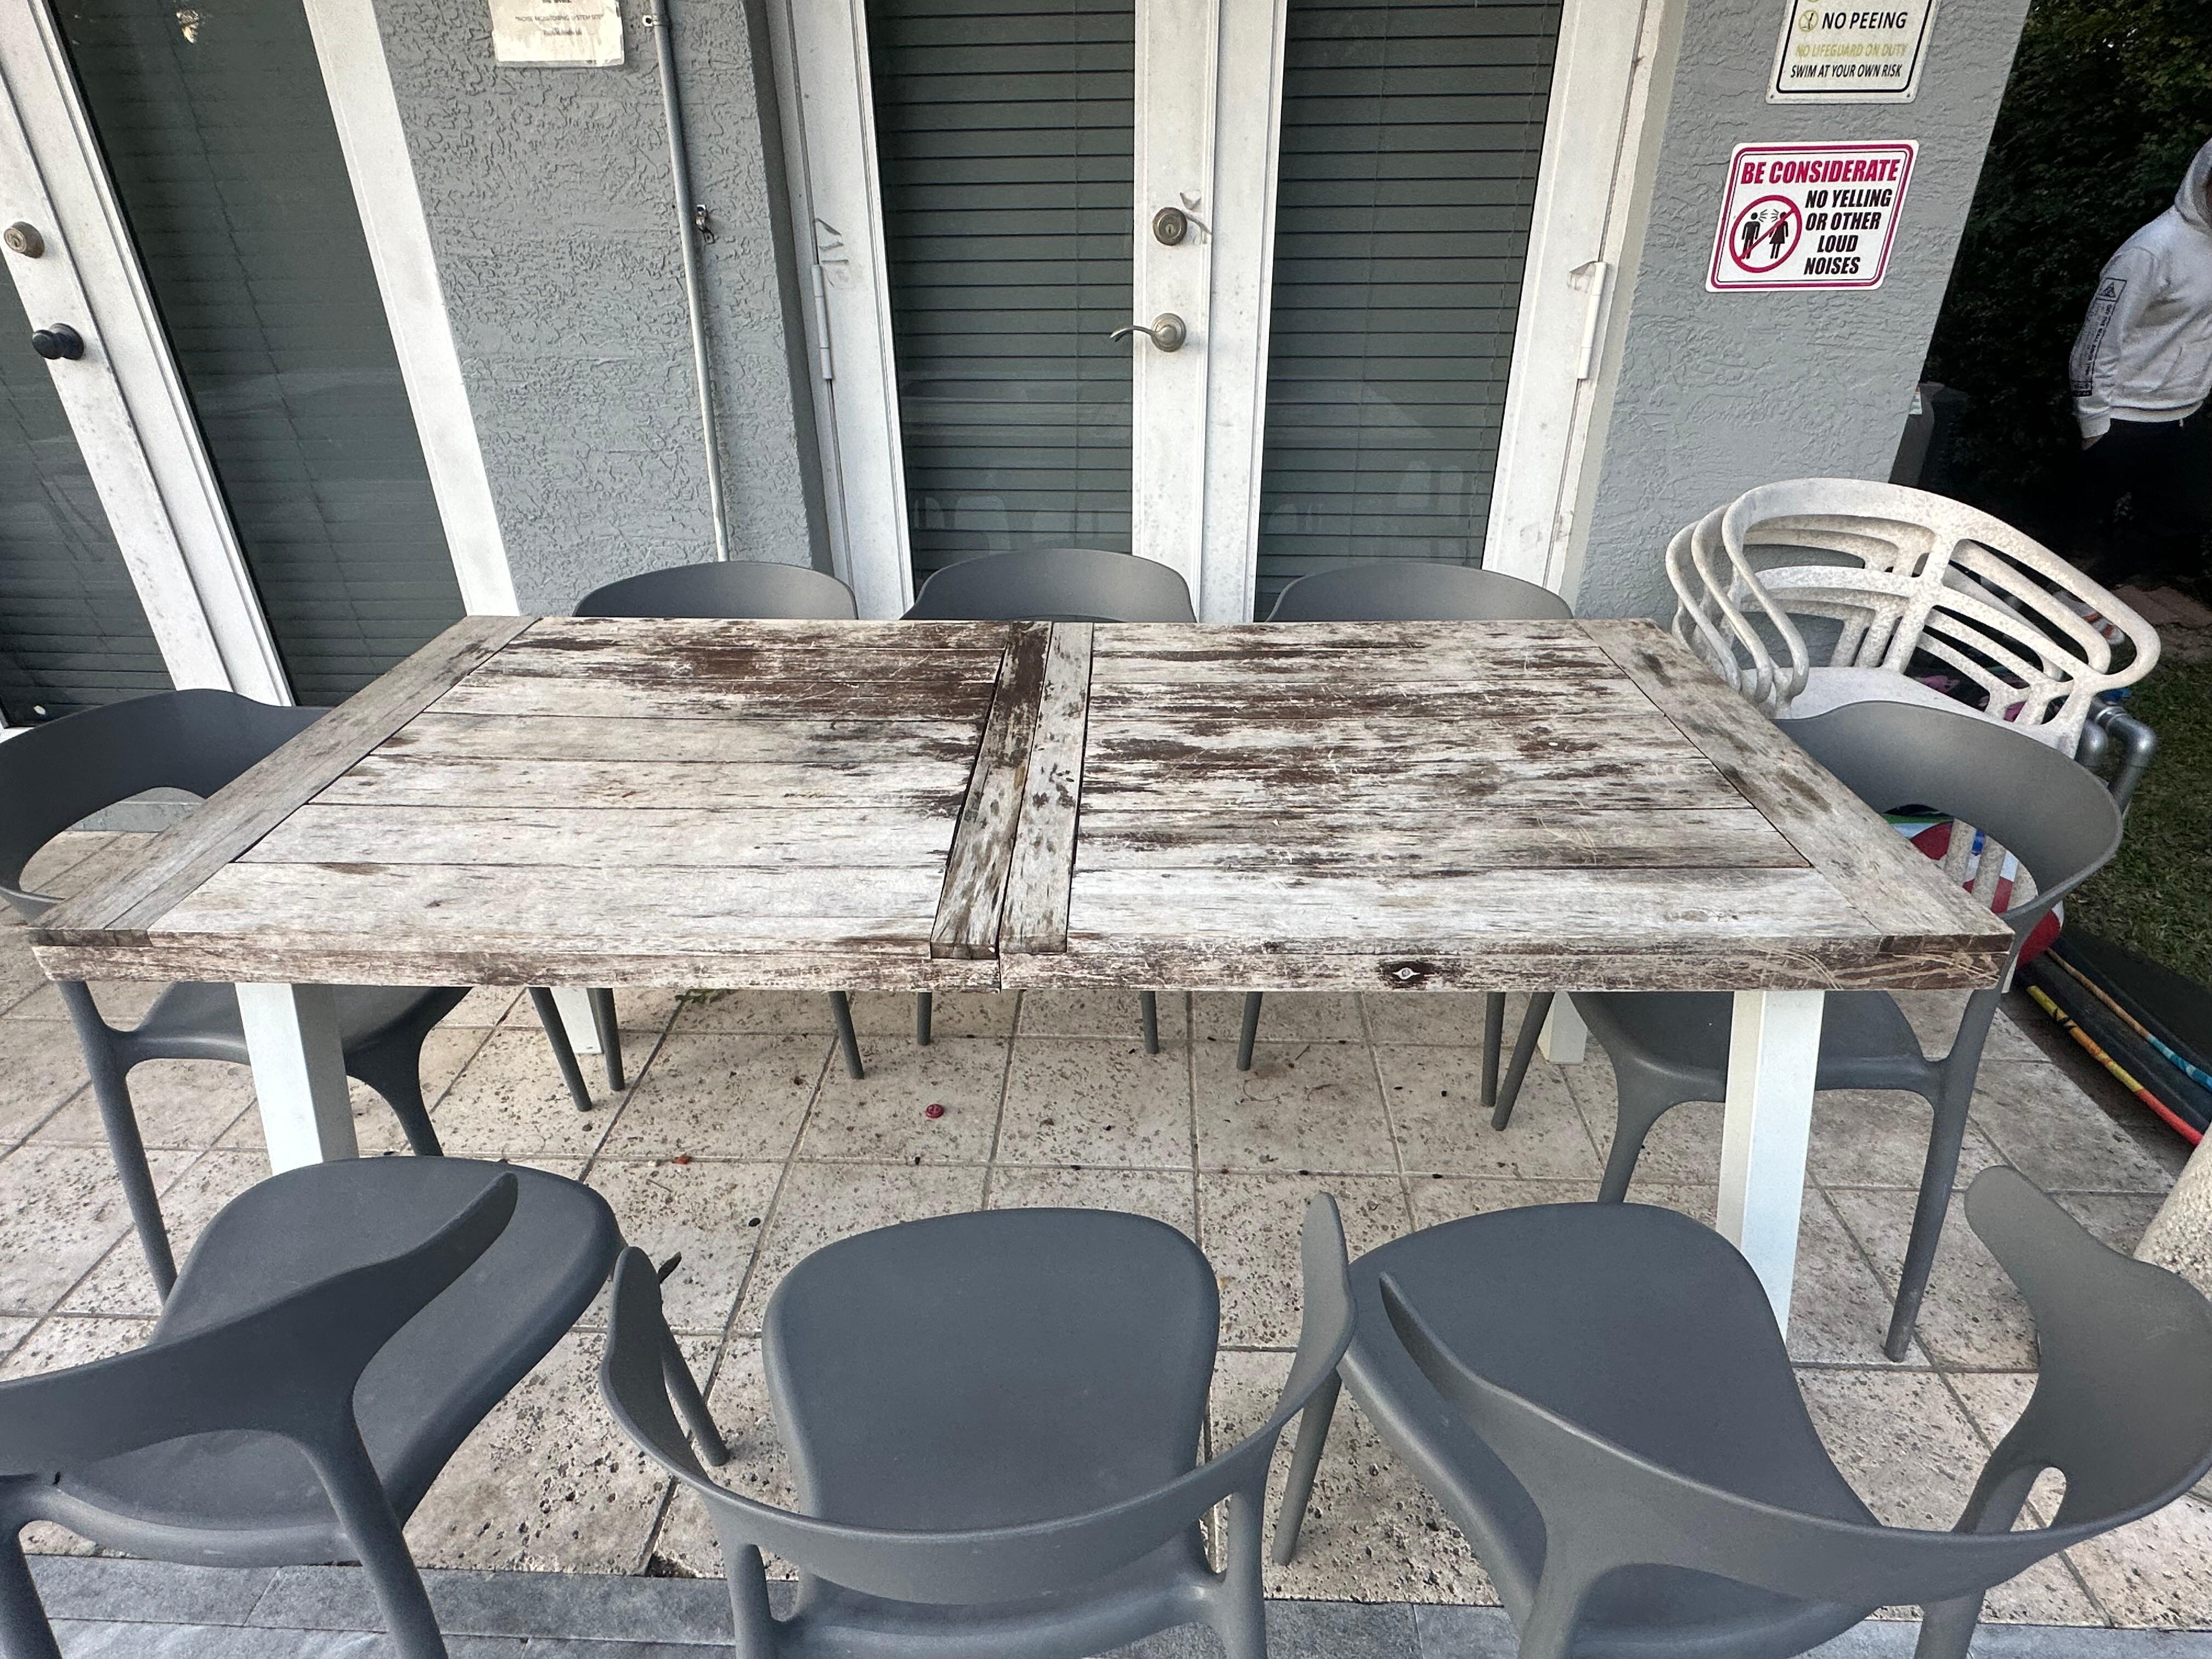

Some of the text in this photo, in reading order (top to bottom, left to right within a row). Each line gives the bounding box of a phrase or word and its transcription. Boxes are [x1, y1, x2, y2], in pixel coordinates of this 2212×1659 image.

[1821, 12, 1908, 29] NO PEEING
[1796, 43, 1907, 57] NO LIFEGUARD ON DUTY
[1790, 64, 1903, 78] SWIM AT YOUR OWN RISK
[1741, 159, 1901, 184] BE CONSIDERATE
[1805, 189, 1893, 208] NO YELLING
[1805, 212, 1882, 231] OR OTHER
[1817, 235, 1859, 253] LOUD
[1803, 257, 1861, 275] NOISES
